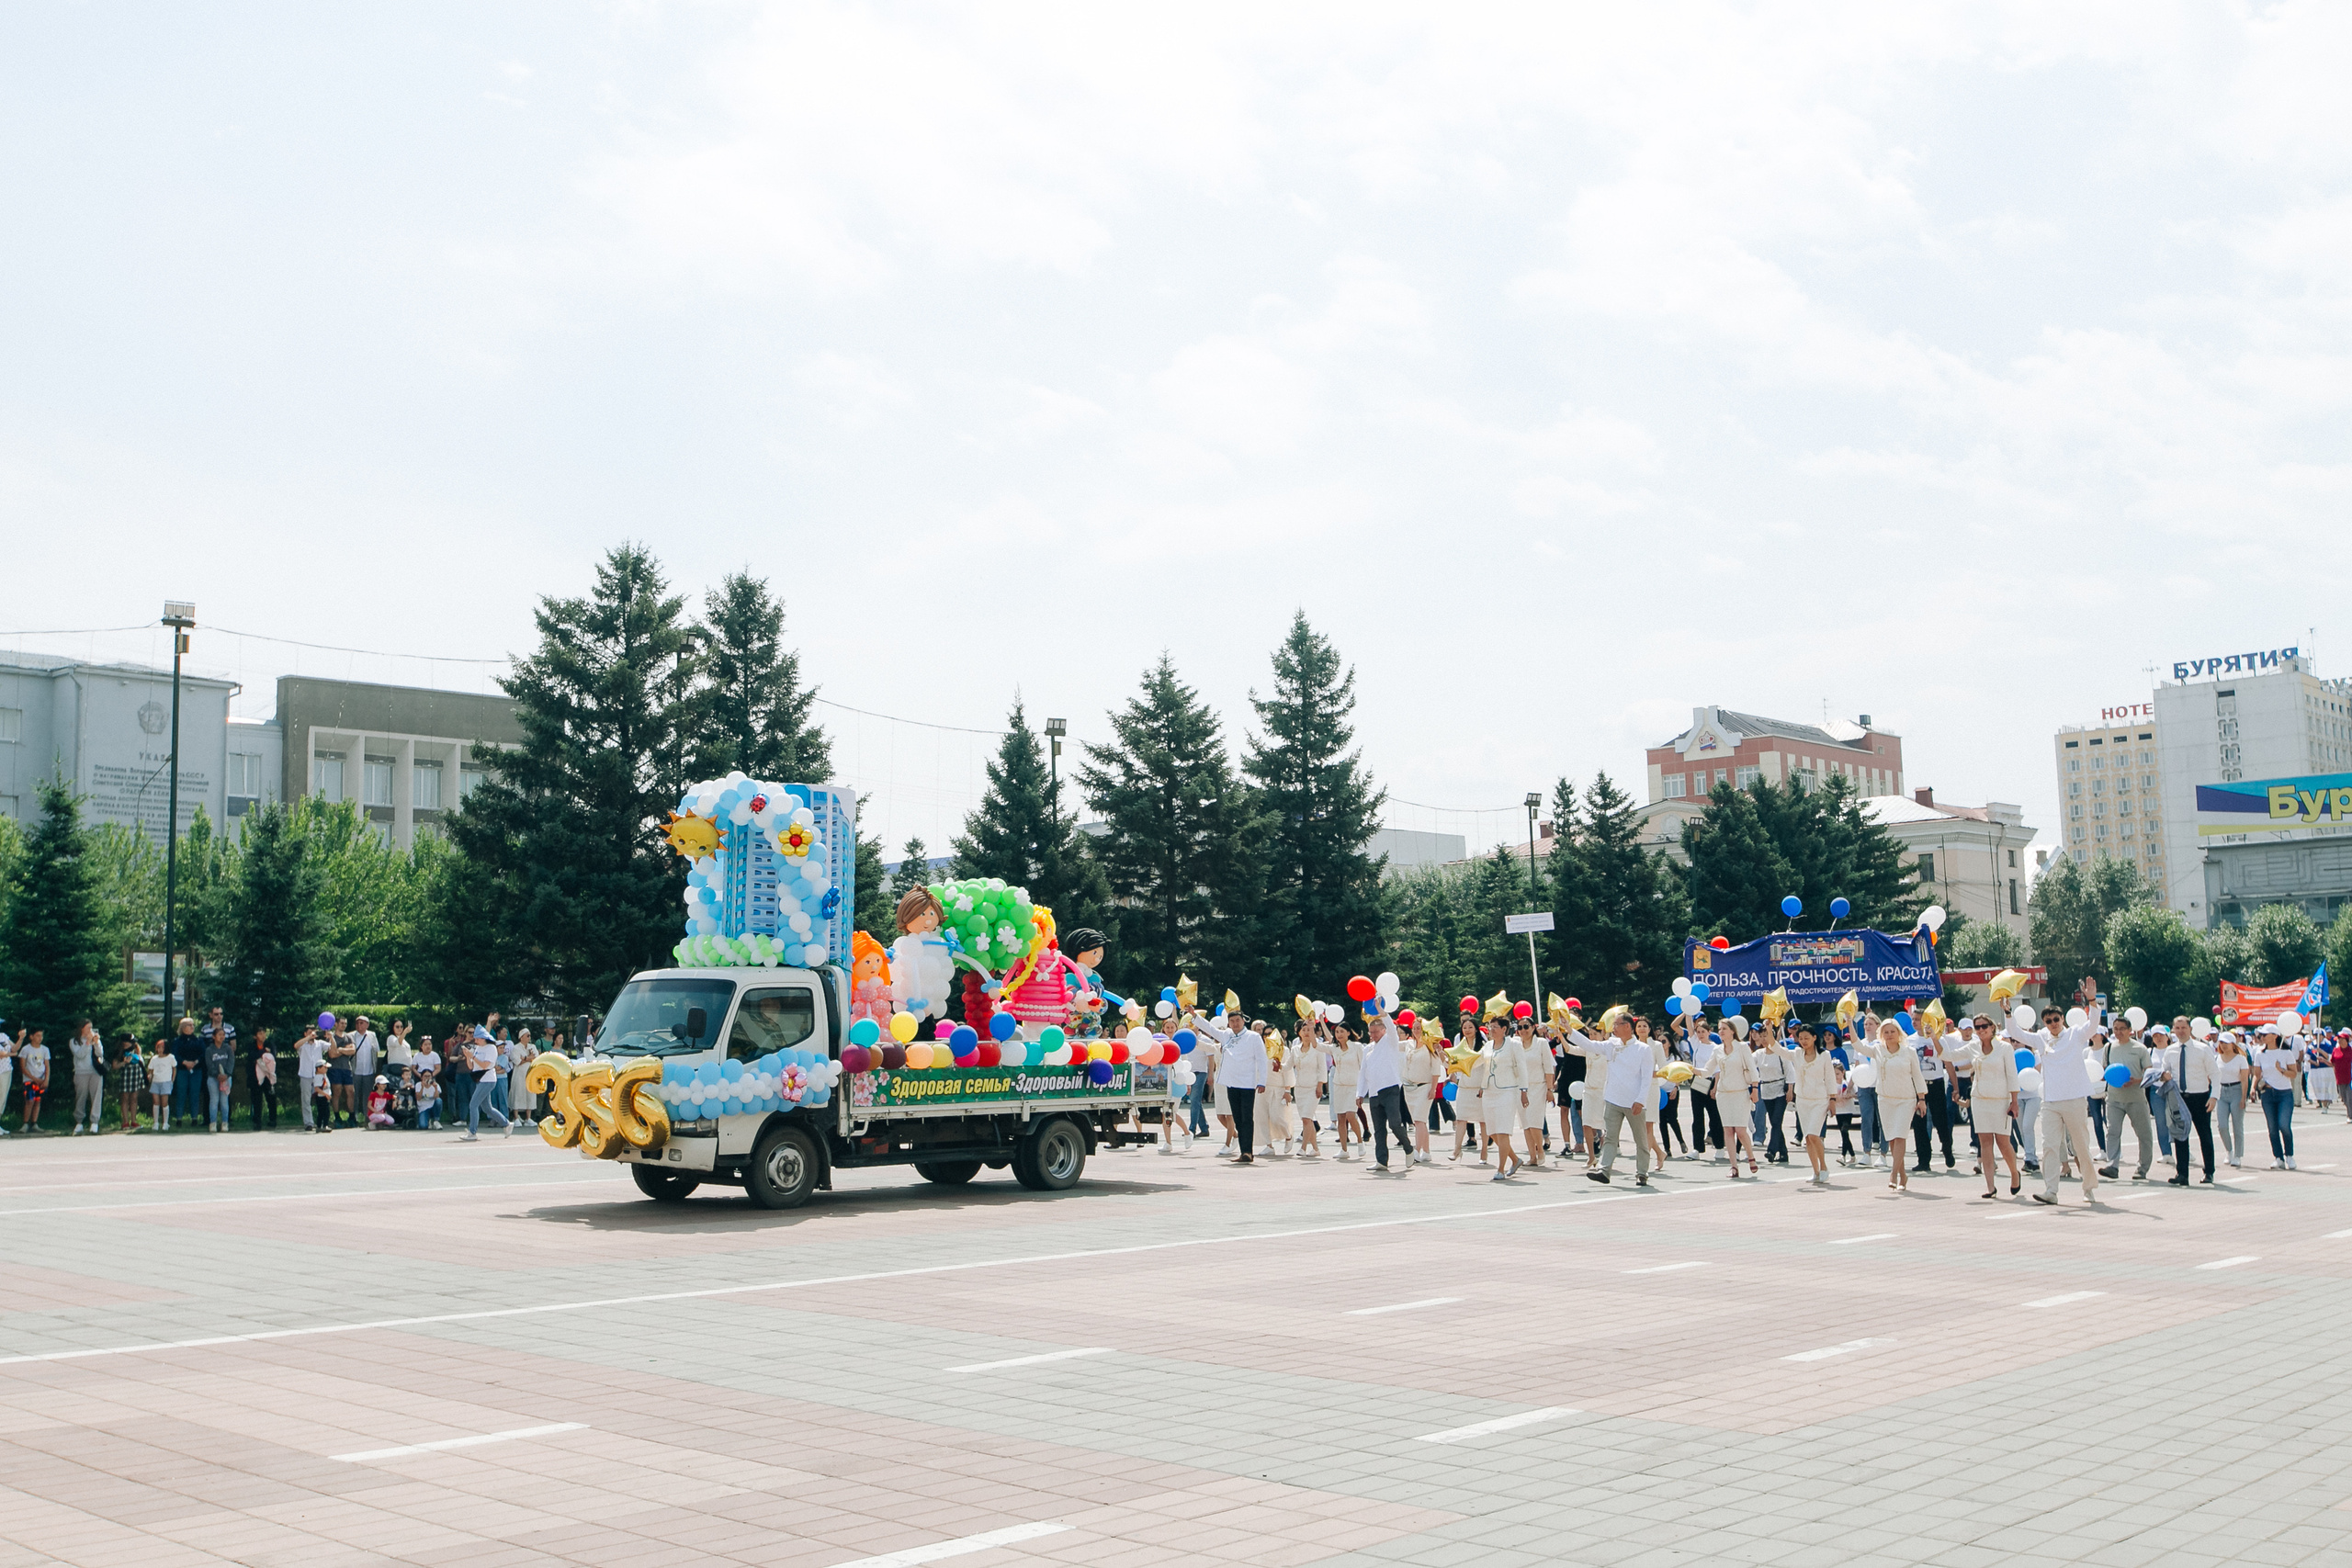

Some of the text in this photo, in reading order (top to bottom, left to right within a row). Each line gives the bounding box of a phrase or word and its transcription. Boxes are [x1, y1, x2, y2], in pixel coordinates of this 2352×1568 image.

[2173, 647, 2298, 679] БУРЯТИЯ
[2101, 703, 2154, 720] HOTE
[2267, 784, 2352, 823] Бур
[1692, 964, 1936, 987] ПОЛЬЗА, ПРОЧНОСТЬ, КРАСОТА
[1736, 989, 1773, 998] АРХИТЕКТУ
[1861, 985, 1911, 993] АДМИНИСТРАЦИИ
[890, 1076, 962, 1100] Здоровая
[526, 1052, 671, 1160] 356
